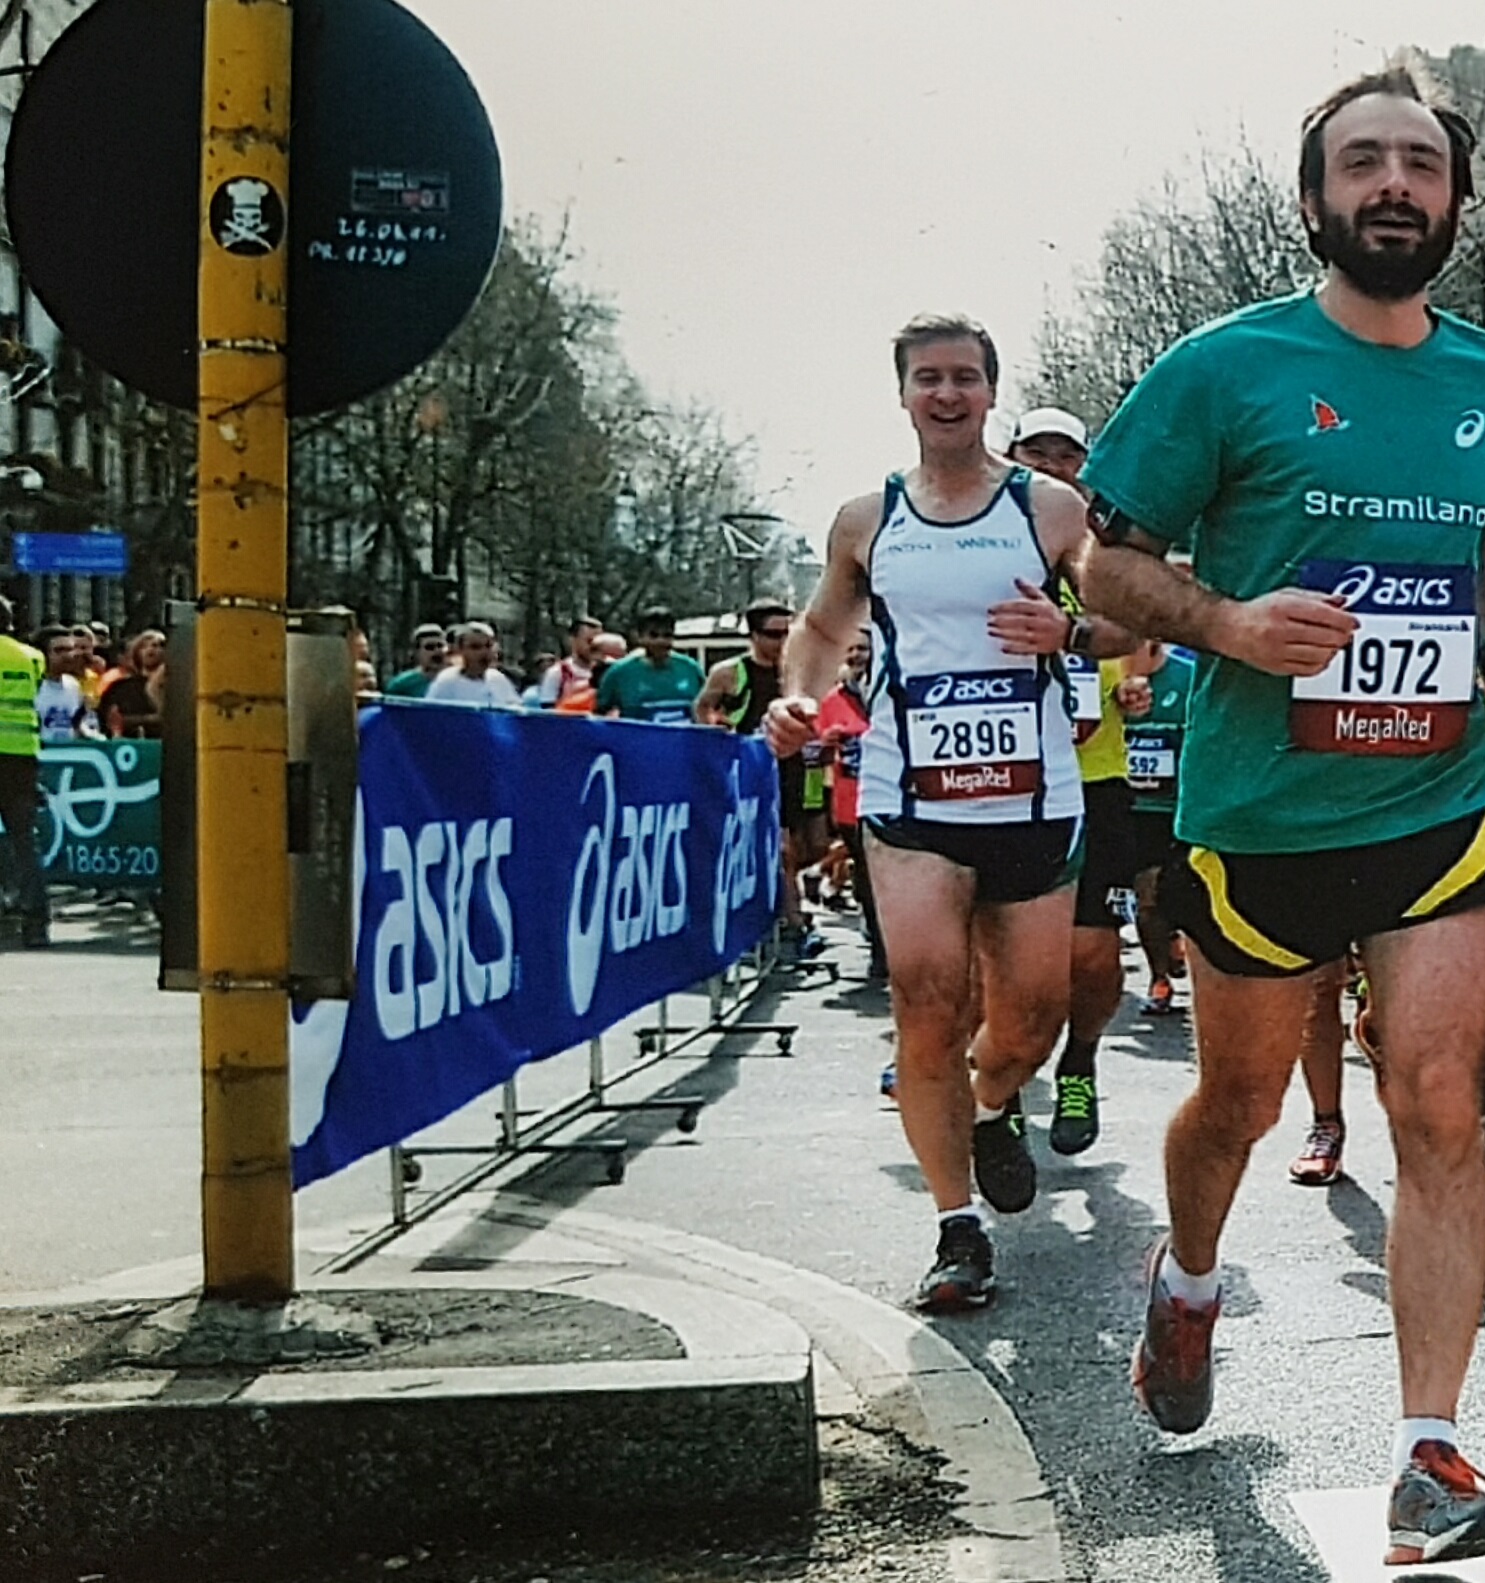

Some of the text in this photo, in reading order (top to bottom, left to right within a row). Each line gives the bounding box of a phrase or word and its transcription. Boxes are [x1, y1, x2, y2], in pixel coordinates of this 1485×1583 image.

[1372, 576, 1453, 607] asics
[1341, 636, 1443, 696] 1972
[953, 677, 1015, 700] asics
[930, 718, 1018, 761] 2896
[1334, 706, 1432, 744] MegaRed
[941, 765, 1013, 794] MegaRed
[611, 801, 691, 953] asics
[374, 816, 514, 1041] asics
